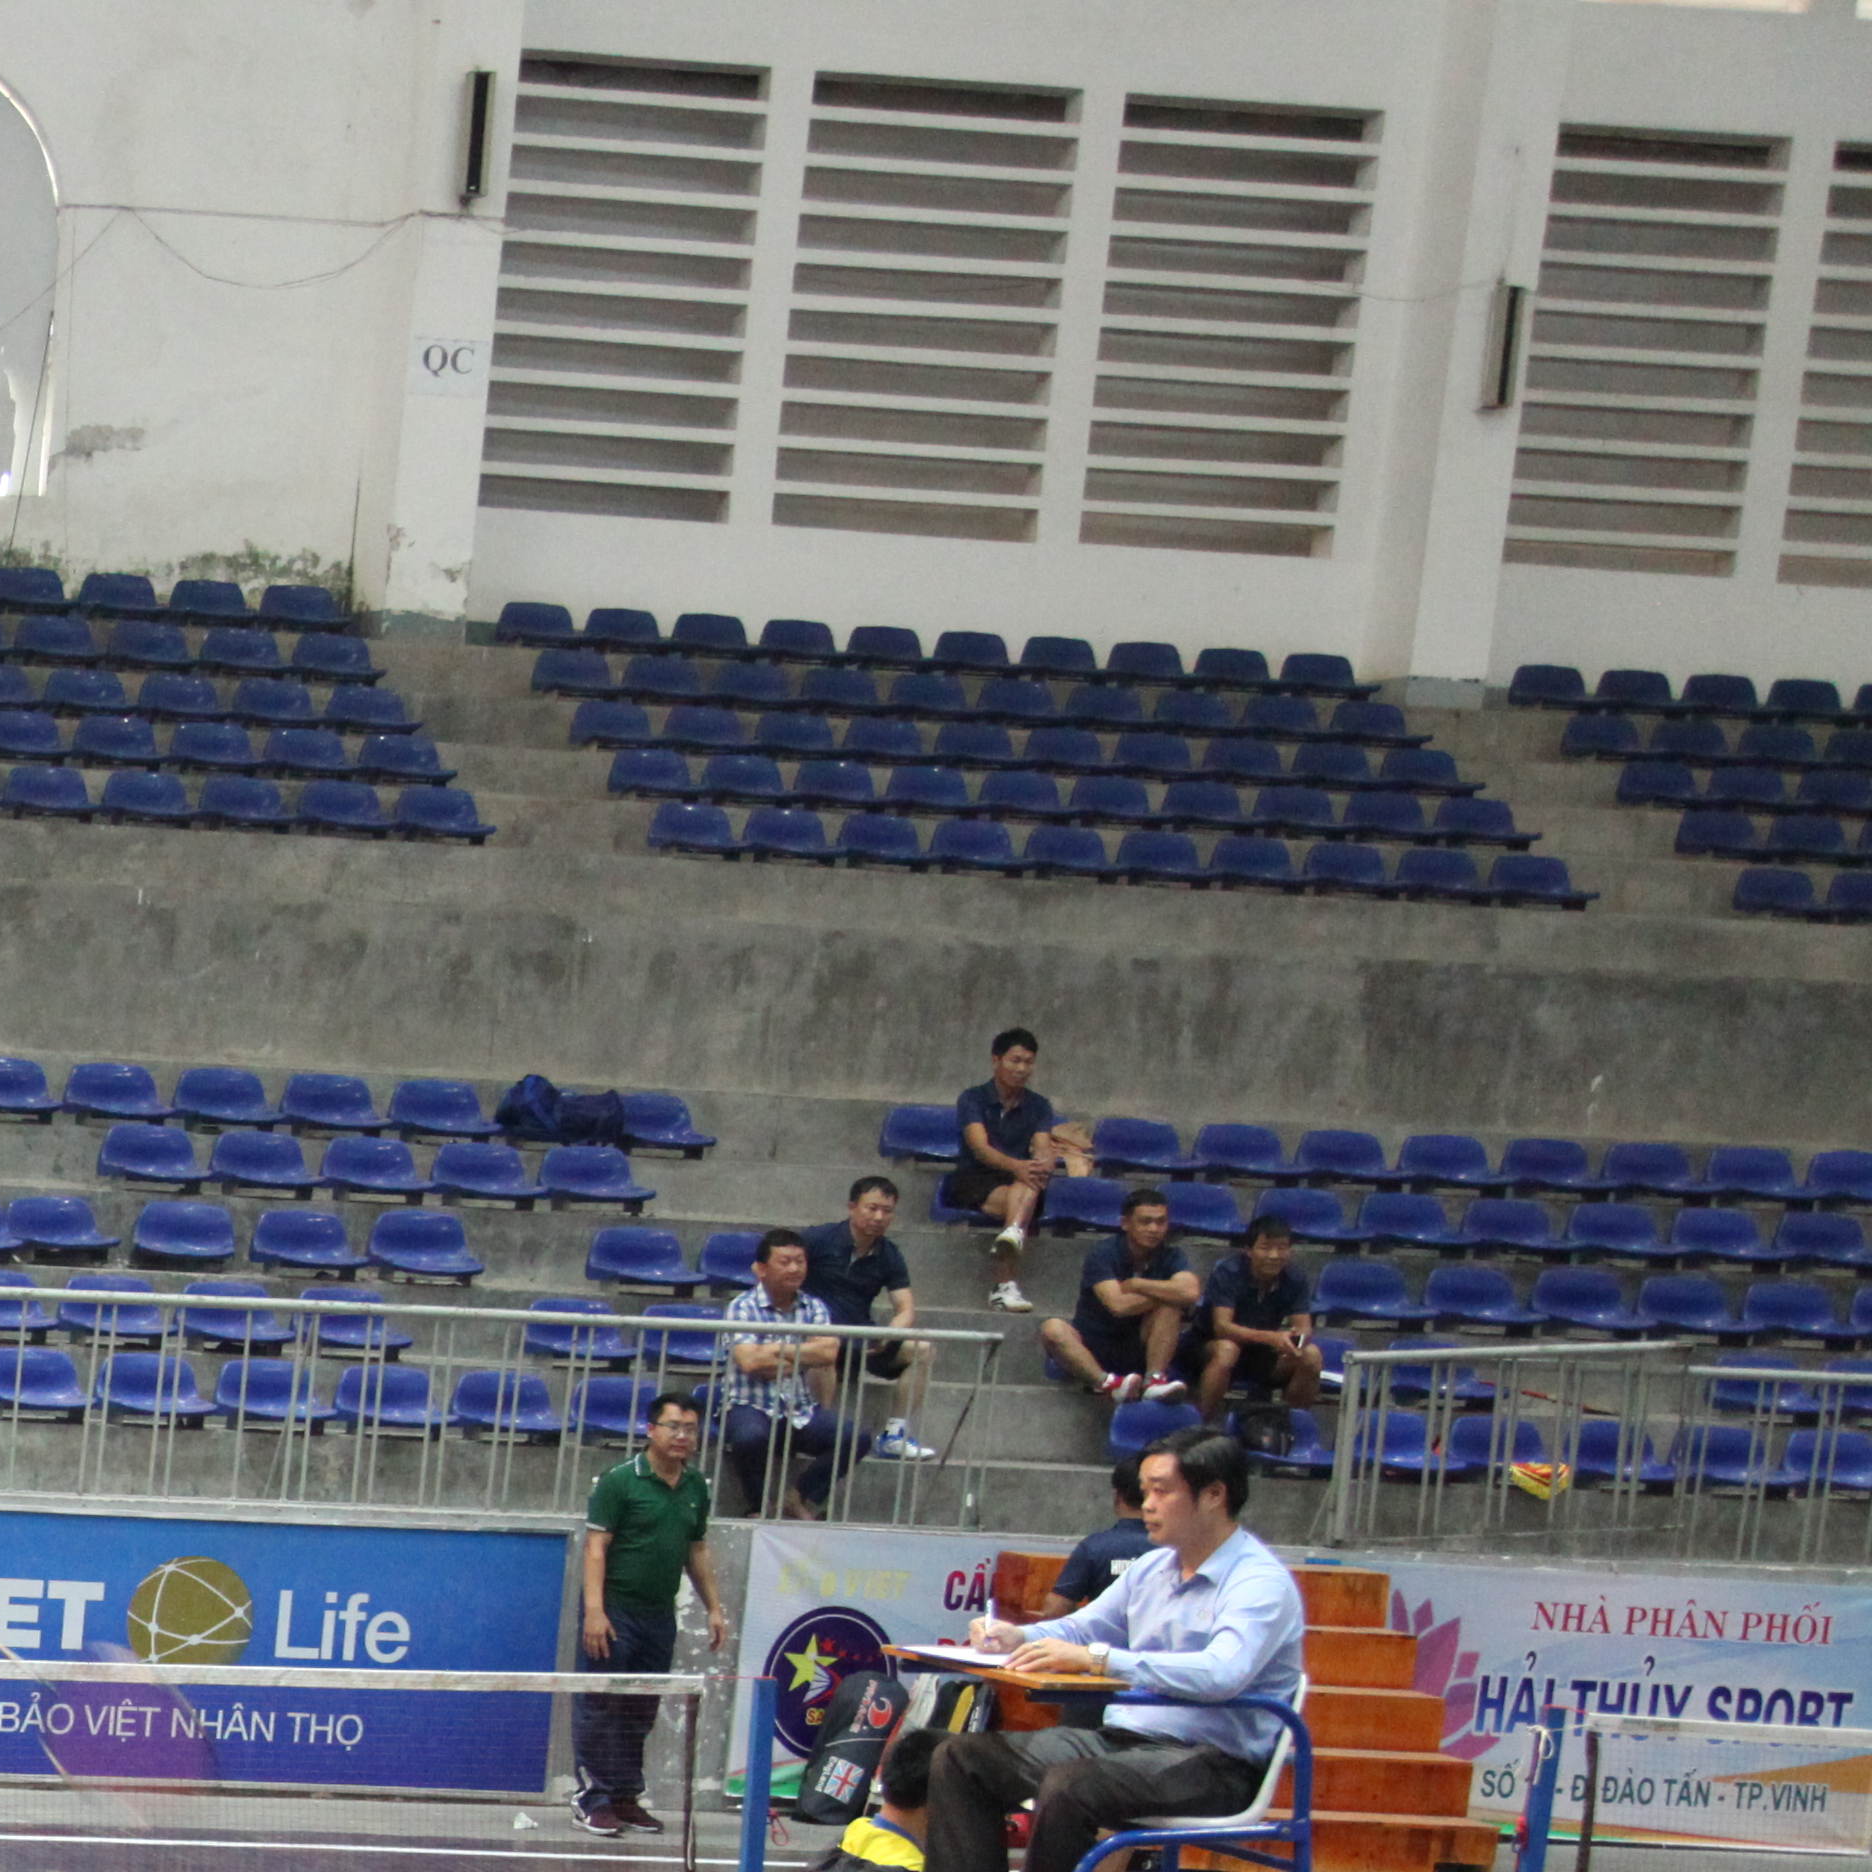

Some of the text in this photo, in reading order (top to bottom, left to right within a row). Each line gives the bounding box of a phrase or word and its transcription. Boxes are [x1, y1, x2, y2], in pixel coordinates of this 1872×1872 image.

[423, 344, 475, 378] QC
[942, 1556, 996, 1613] CẦ
[274, 1588, 412, 1665] Life
[1530, 1594, 1834, 1645] NHÀ PHÂN PHỐI
[84, 1698, 161, 1743] VIỆT
[170, 1702, 277, 1743] NHÂN
[286, 1711, 364, 1752] THỌ
[1569, 1655, 1695, 1741] THỦY
[1706, 1686, 1854, 1749] SPORT
[1480, 1759, 1520, 1799] SỐ
[1601, 1767, 1655, 1806] ĐÀO
[1663, 1768, 1711, 1807] TẤN
[1734, 1781, 1829, 1813] TP.VINH
